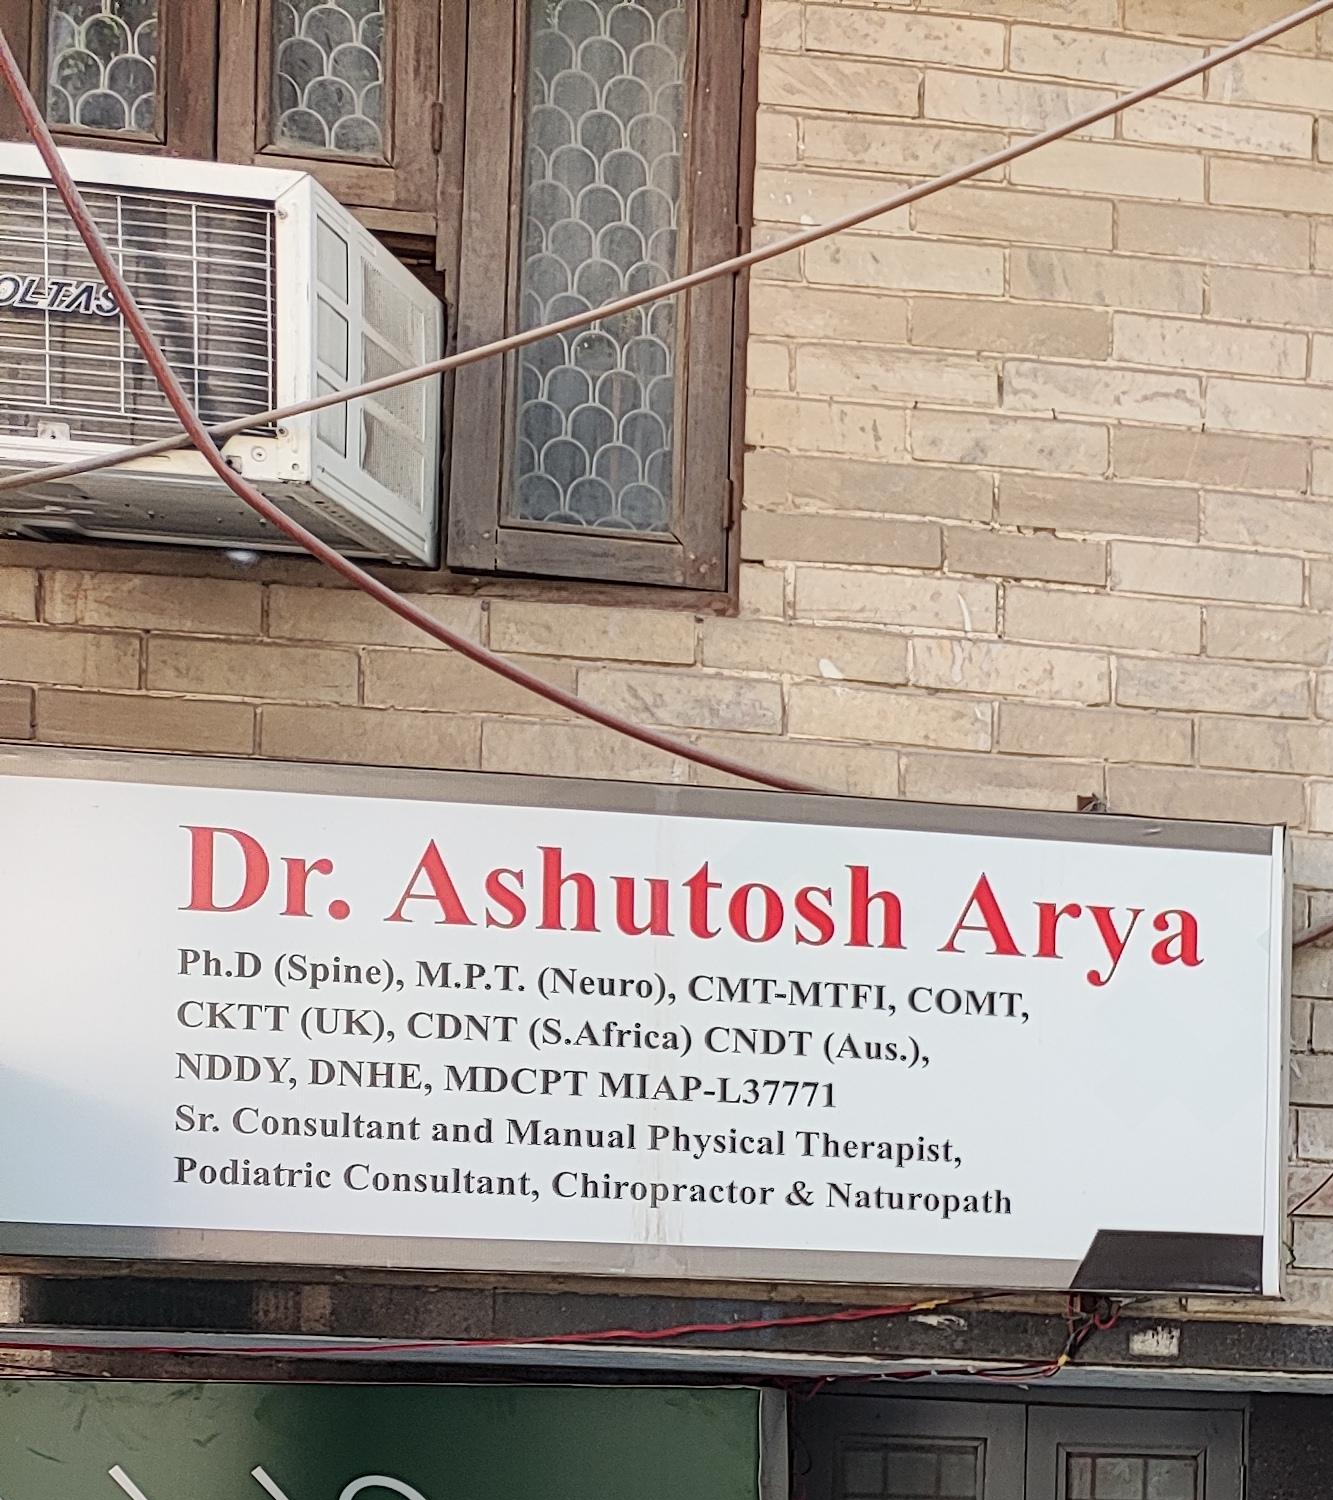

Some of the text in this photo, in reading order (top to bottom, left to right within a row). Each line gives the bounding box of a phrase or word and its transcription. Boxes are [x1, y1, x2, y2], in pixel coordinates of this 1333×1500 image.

[179, 825, 1205, 988] Dr. Ashutosh Arya
[178, 948, 1029, 1024] Ph.D (Spine), M.P.T. (Neuro), CMT-MTFI, COMT,
[177, 1000, 929, 1069] CKTT (UK), CDNT (S.Africa) CNDT (Aus.),
[175, 1052, 835, 1108] NDDY, DNHE, MDCPT MIAP-L37771
[175, 1104, 961, 1169] Sr. Consultant and Manual Physical Therapist,
[174, 1156, 1011, 1219] Podiatric Consultant, Chiropractor & Naturopath
